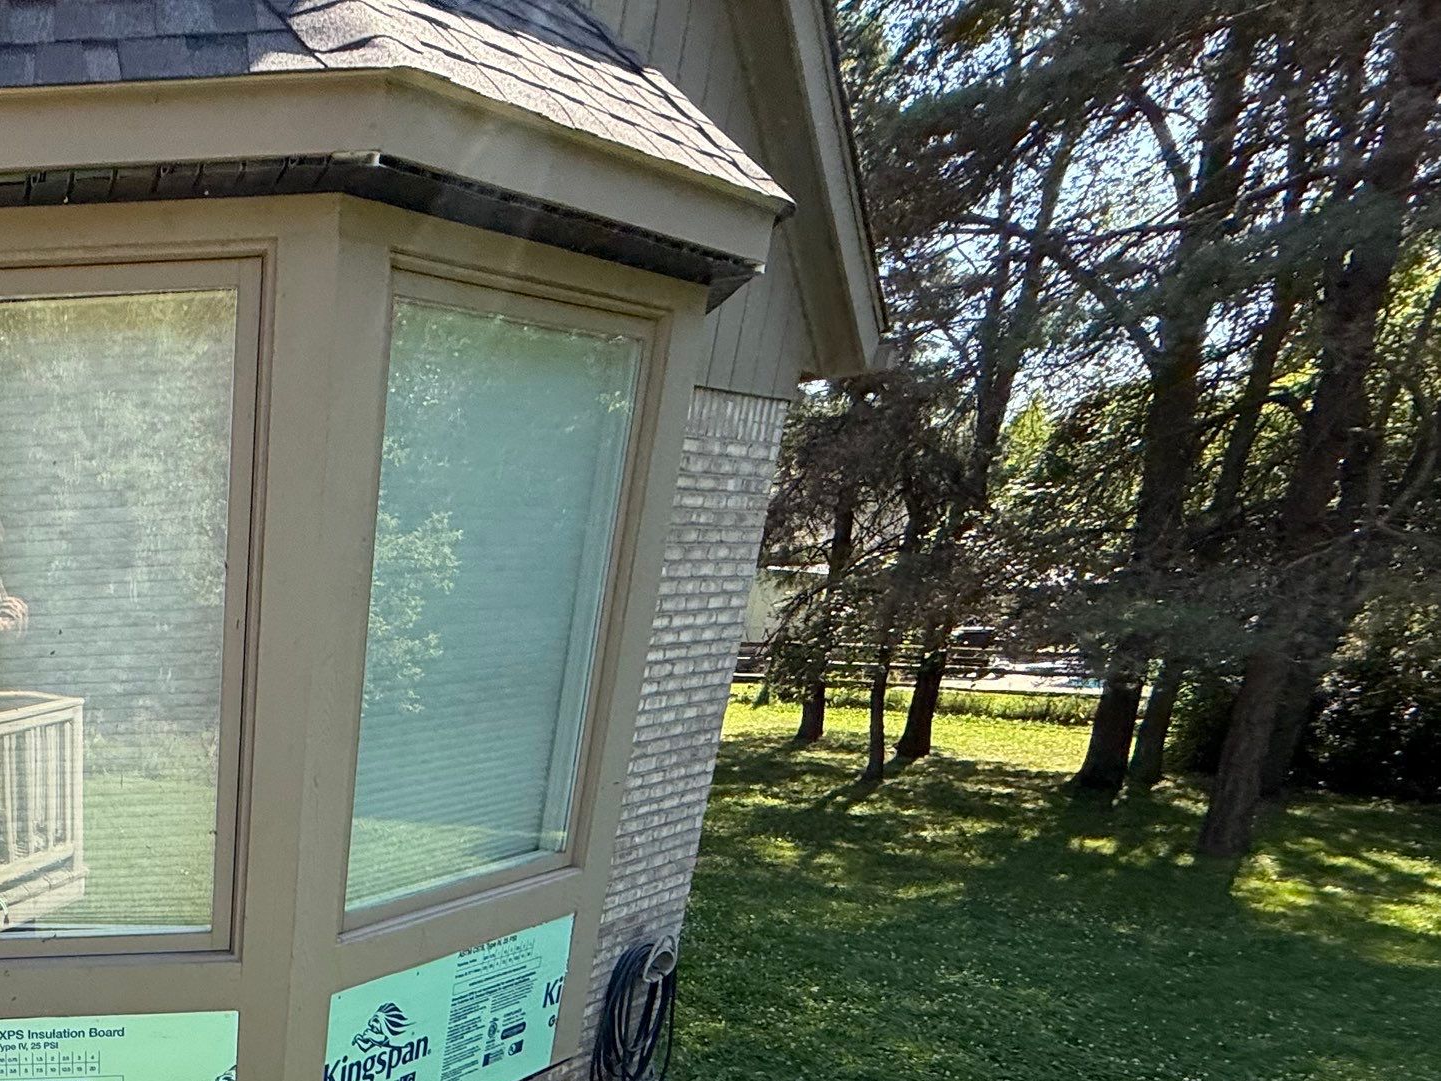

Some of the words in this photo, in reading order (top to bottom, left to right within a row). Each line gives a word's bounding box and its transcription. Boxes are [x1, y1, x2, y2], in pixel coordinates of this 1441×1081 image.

[28, 1028, 85, 1040] Insulation
[88, 1027, 125, 1038] Board
[31, 1042, 42, 1050] 25
[43, 1041, 59, 1050] PSI
